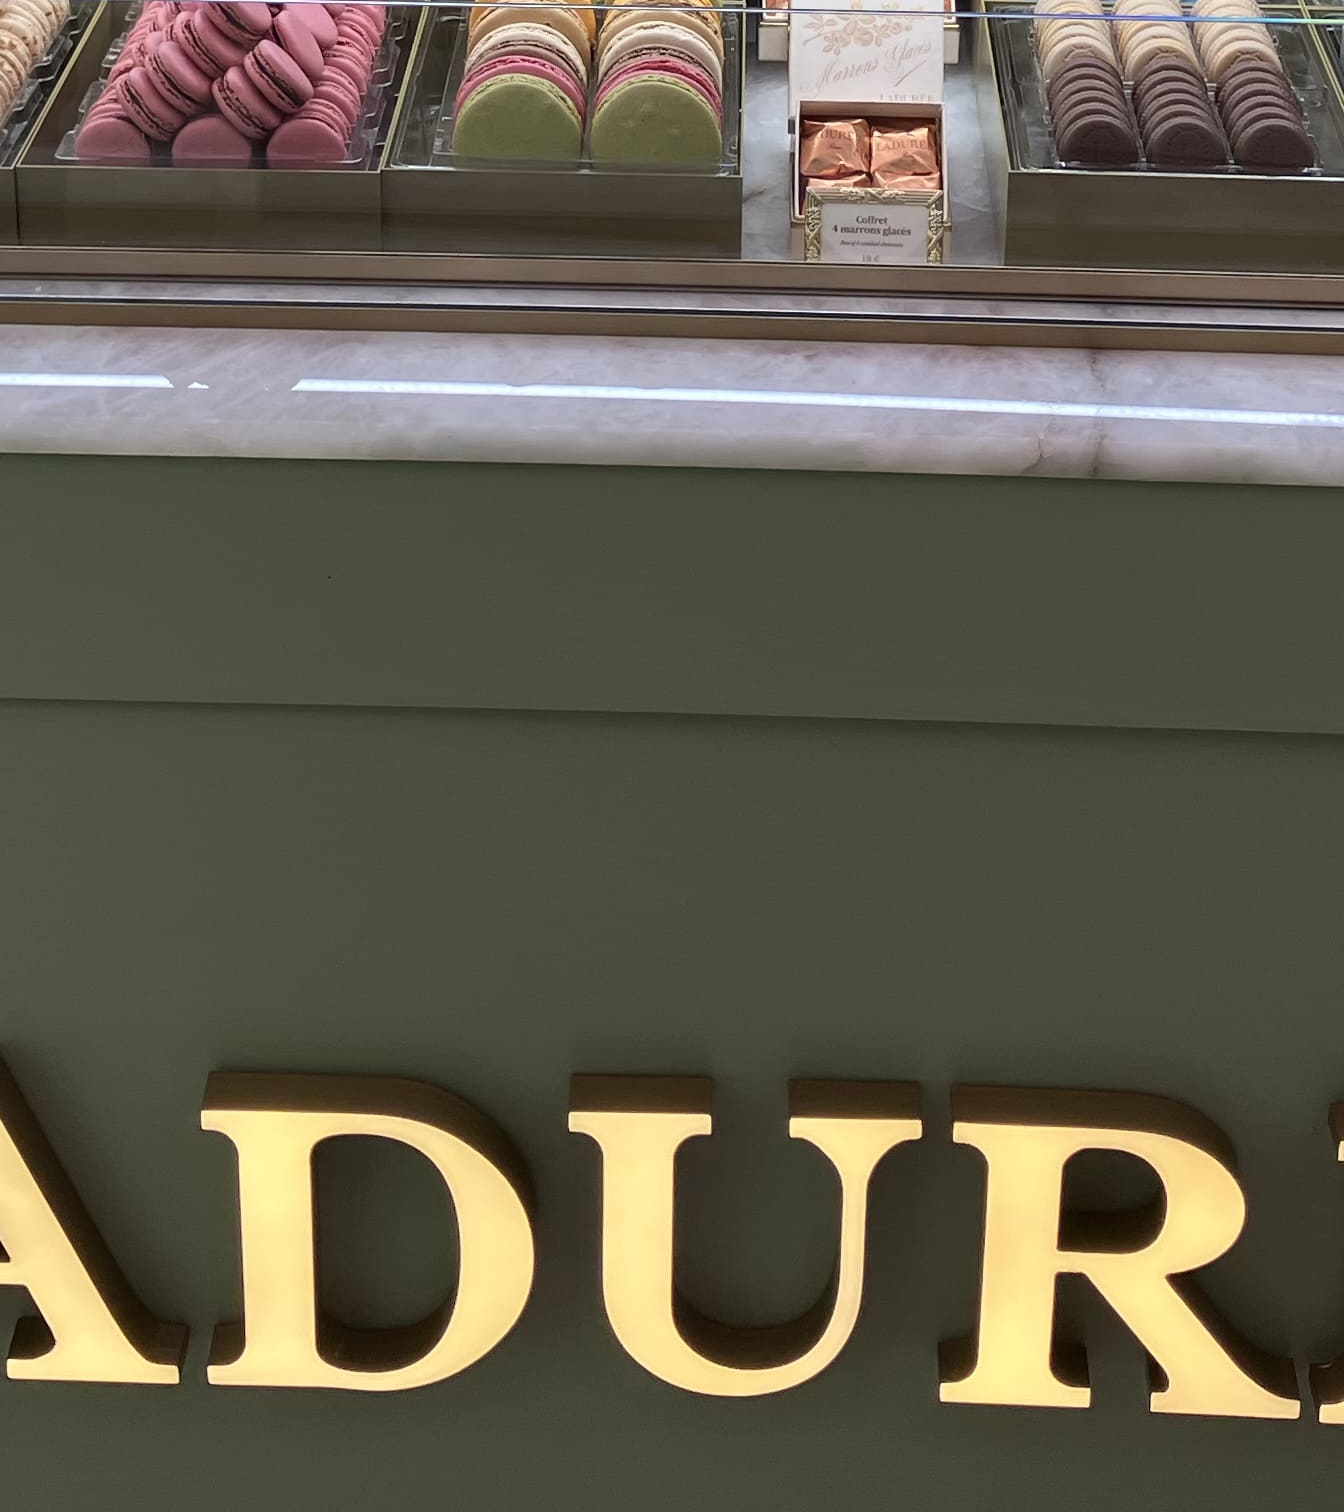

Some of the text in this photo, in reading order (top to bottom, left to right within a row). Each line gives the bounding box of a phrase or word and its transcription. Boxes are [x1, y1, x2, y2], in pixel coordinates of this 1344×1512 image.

[855, 215, 888, 225] Coffret
[832, 224, 912, 237] 4 marrons glacés
